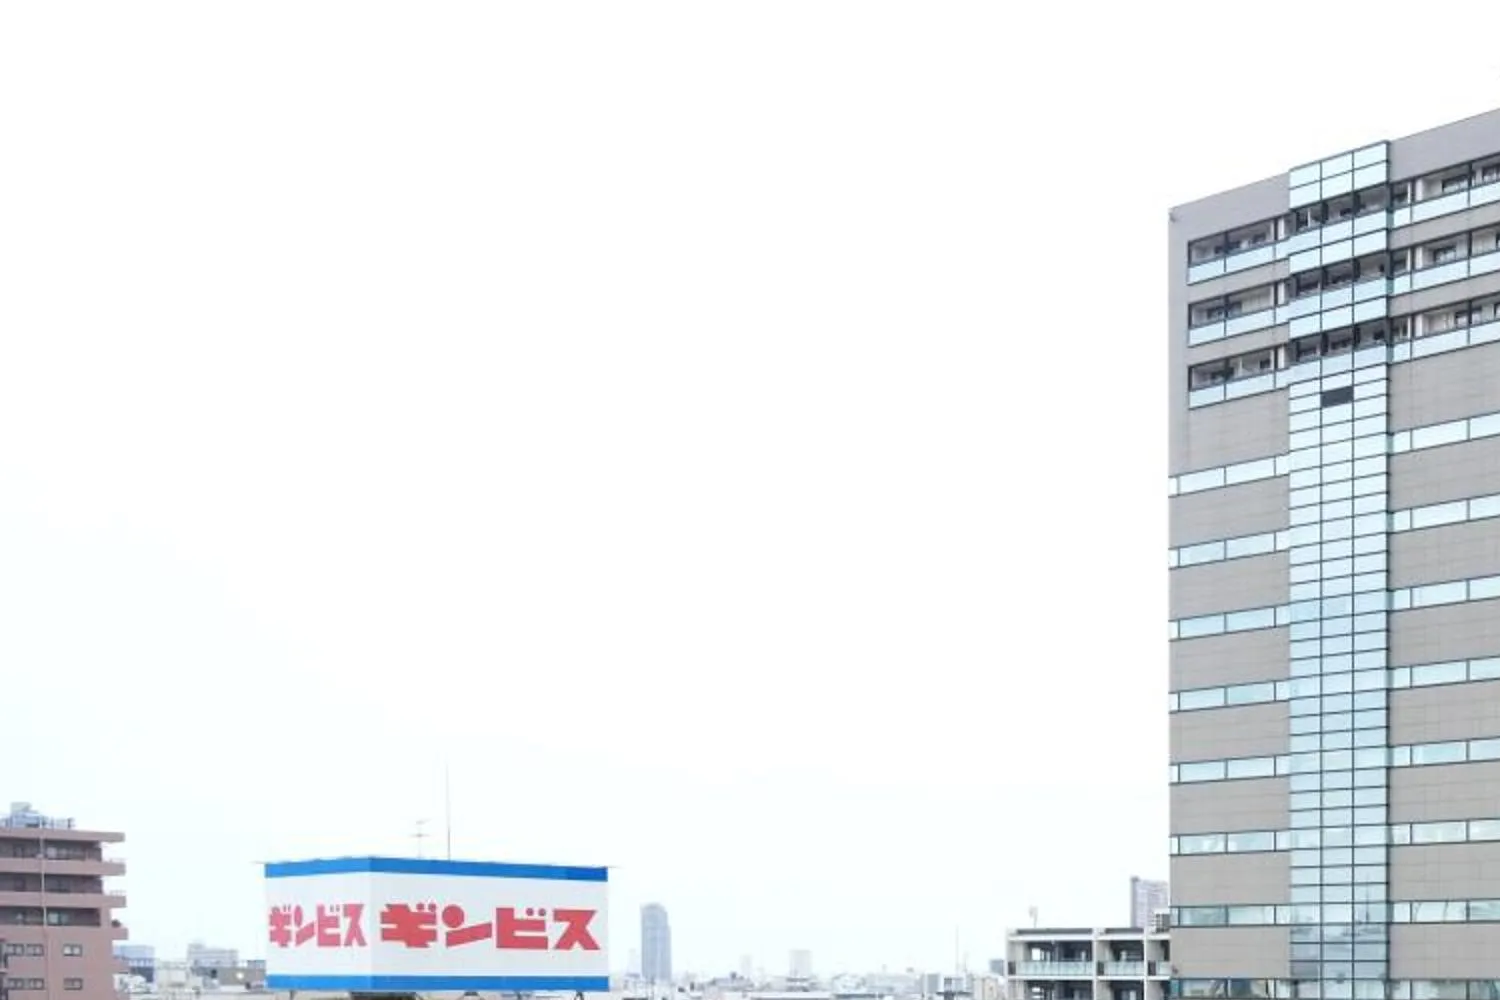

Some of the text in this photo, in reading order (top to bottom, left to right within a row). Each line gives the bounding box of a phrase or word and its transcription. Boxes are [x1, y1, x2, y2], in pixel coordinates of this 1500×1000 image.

[268, 902, 368, 949] ギンビス
[380, 902, 601, 951] ギンビス
